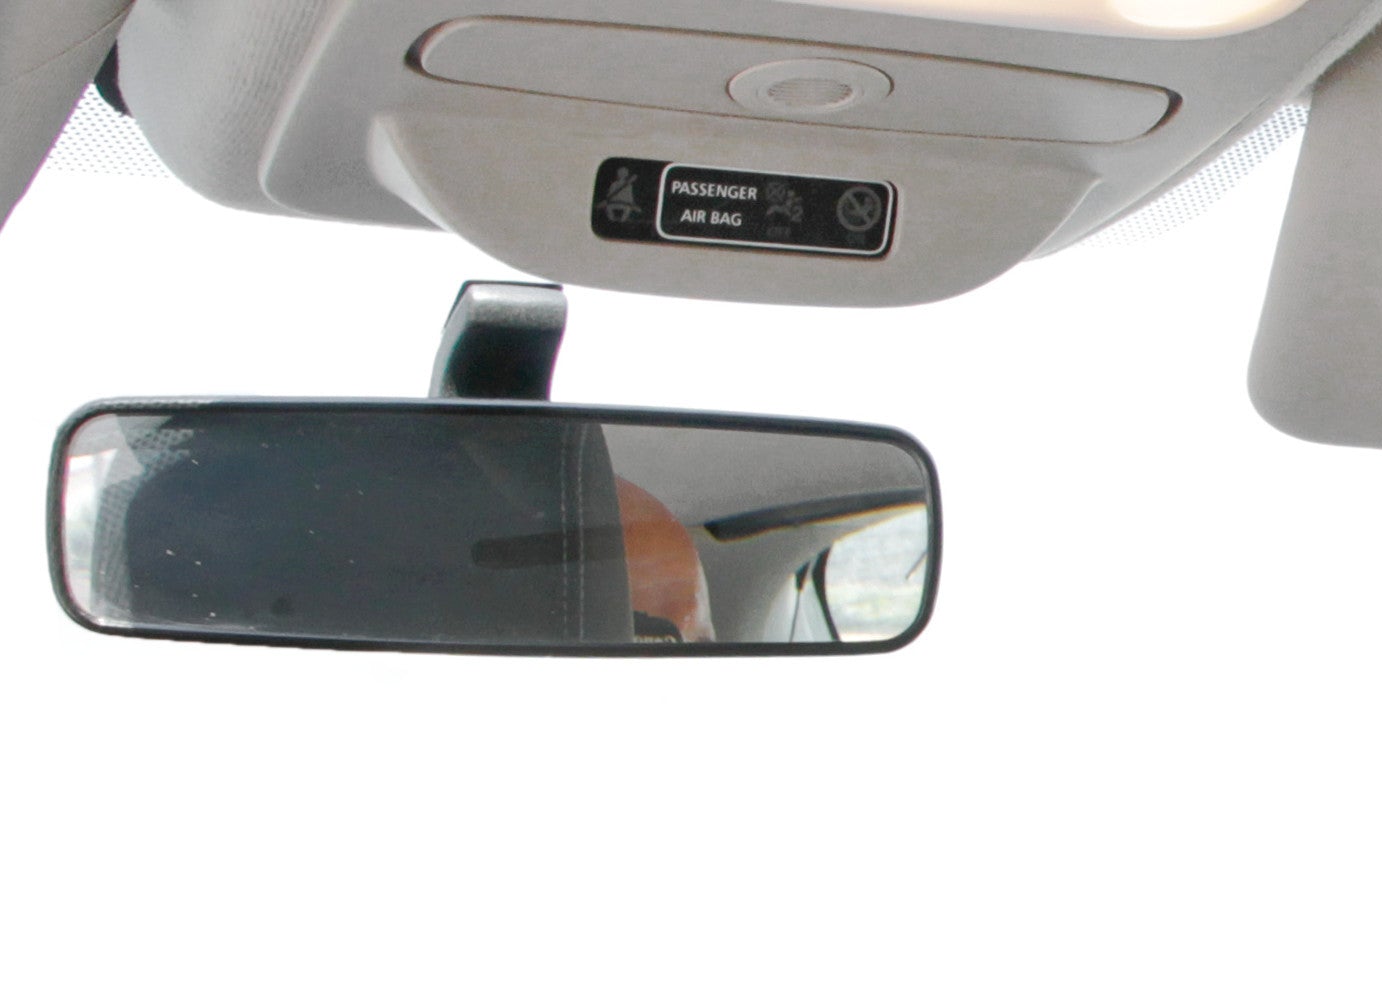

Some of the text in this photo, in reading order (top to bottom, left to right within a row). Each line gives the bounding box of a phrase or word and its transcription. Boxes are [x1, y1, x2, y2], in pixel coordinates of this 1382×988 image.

[671, 180, 758, 201] PASSENGER
[680, 208, 743, 227] AIR BAG
